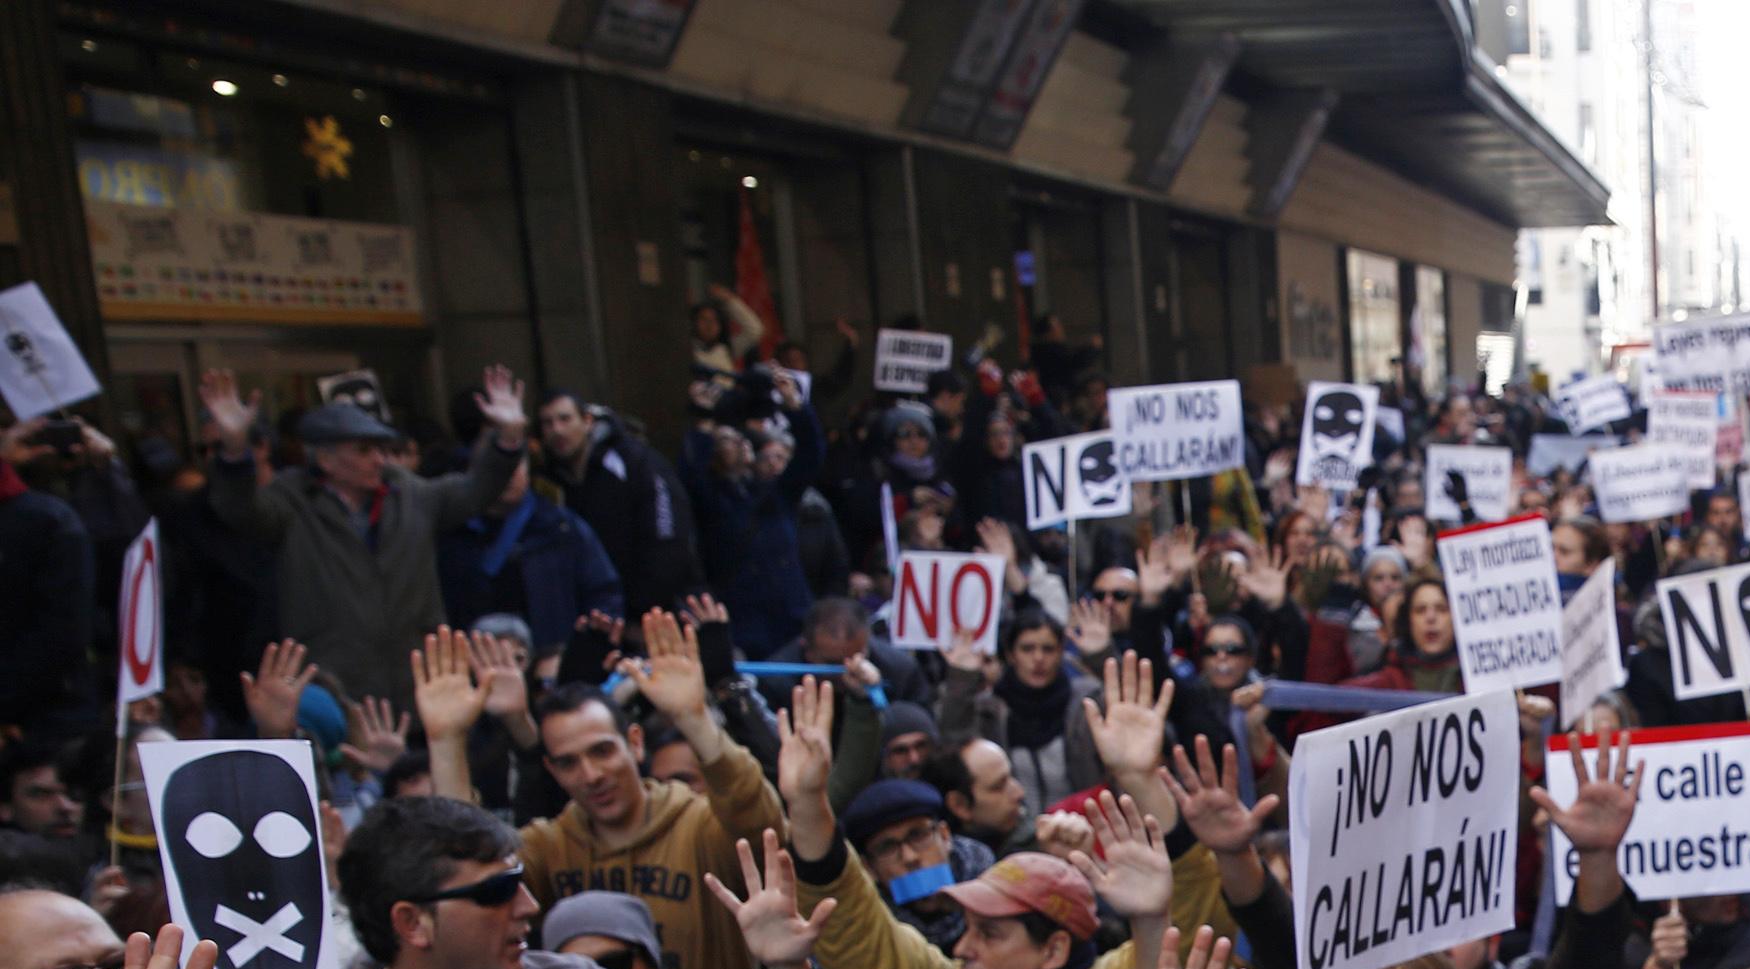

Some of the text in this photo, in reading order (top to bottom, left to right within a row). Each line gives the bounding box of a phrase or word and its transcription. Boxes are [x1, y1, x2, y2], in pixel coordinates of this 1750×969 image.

[1176, 389, 1220, 422] NOS
[1447, 543, 1478, 582] Ley
[899, 561, 993, 641] NO
[1459, 578, 1554, 625] DICTADURA
[1468, 628, 1559, 676] DESCARADA
[1330, 707, 1487, 858] ¡NO NOS
[1656, 752, 1744, 800] calle
